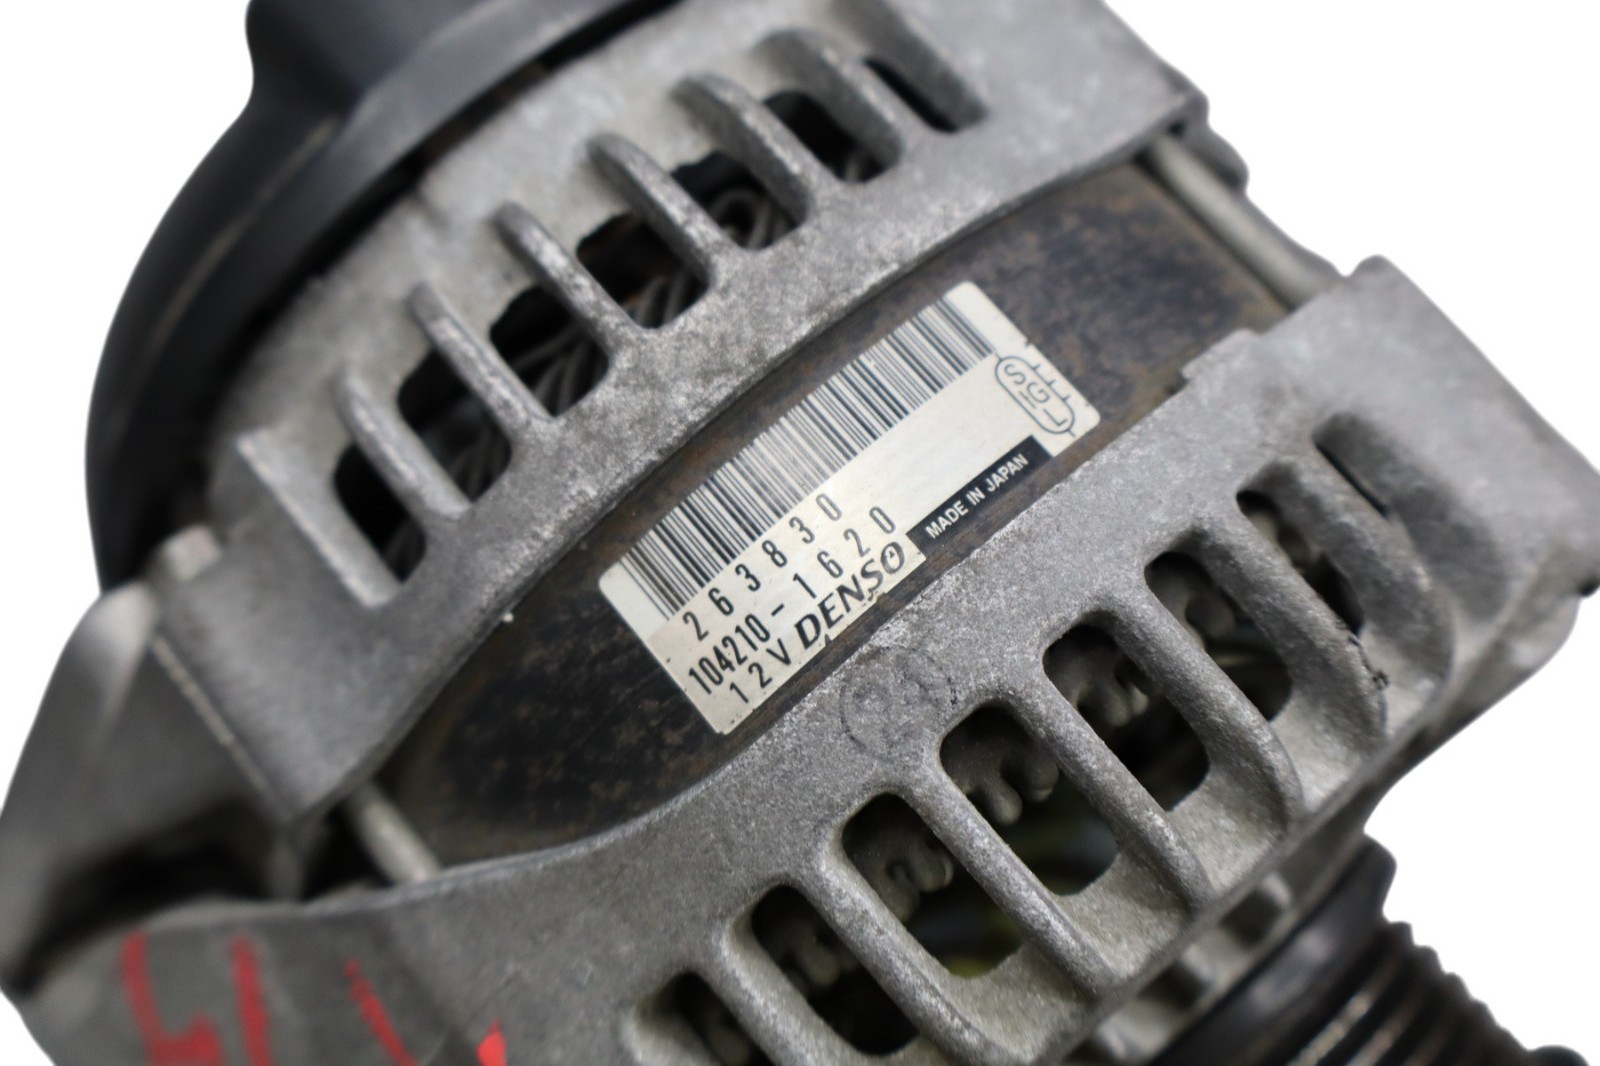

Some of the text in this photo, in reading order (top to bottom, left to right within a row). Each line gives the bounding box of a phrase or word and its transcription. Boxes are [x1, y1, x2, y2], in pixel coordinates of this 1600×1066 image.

[1004, 363, 1026, 385] S
[1043, 408, 1068, 427] L
[925, 454, 1029, 538] MADE IN JAPAN
[795, 541, 905, 649] DENSO
